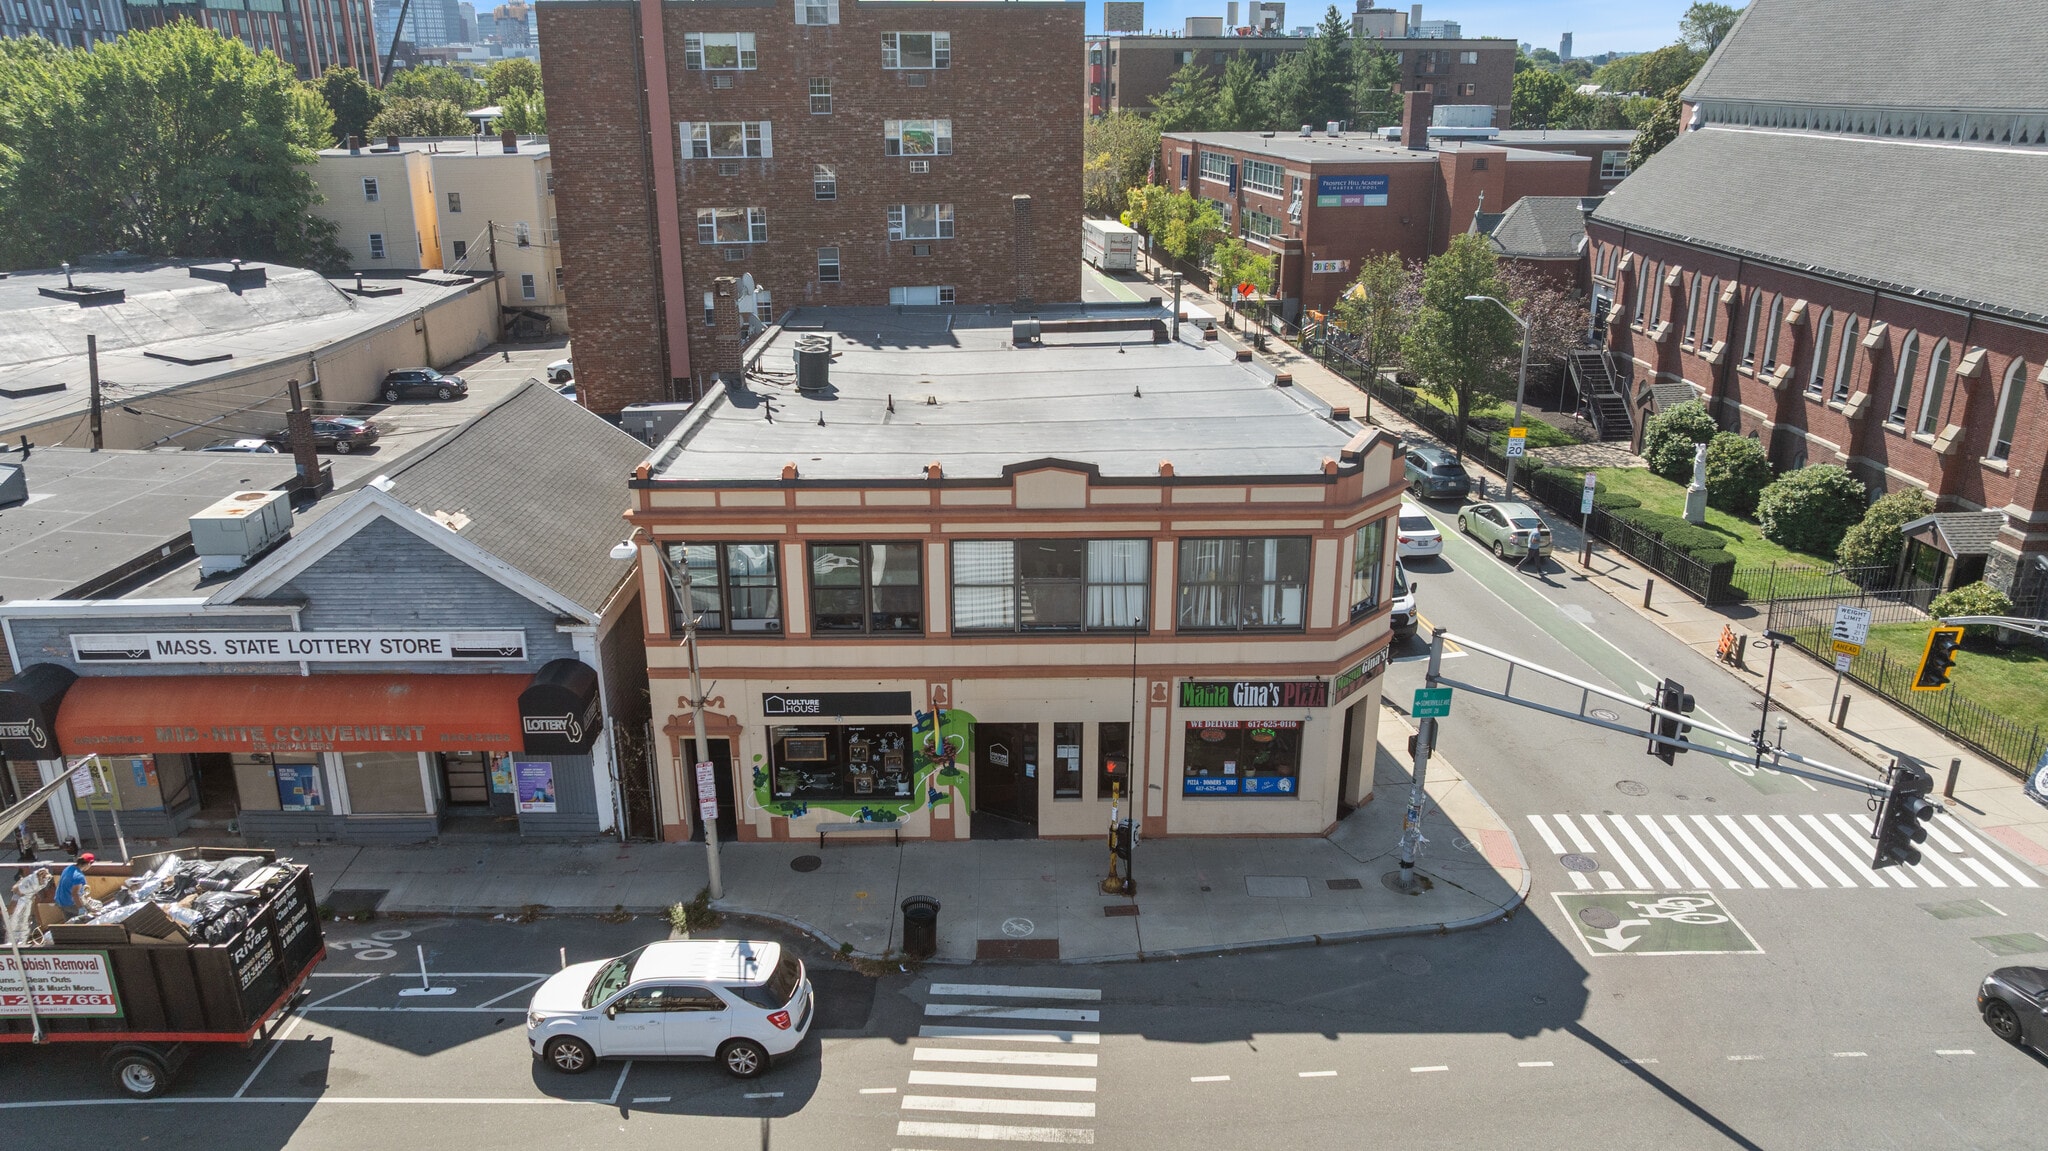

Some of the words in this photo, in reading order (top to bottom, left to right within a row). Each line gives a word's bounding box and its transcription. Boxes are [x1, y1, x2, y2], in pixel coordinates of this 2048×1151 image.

[1508, 446, 1522, 455] 20
[1841, 607, 1867, 617] WEIGHT
[1843, 614, 1862, 622] LIMIT
[156, 639, 217, 656] MASS.
[224, 639, 280, 655] STATE
[288, 638, 371, 655] LOTTERY
[380, 638, 442, 654] STORE
[1836, 643, 1857, 653] AHEAD
[1182, 682, 1229, 707] Mama
[1233, 682, 1280, 707] Gina's
[1283, 682, 1325, 707] PIZZA
[786, 705, 820, 713] HOUSE
[526, 719, 568, 731] LOTTERY
[1190, 720, 1203, 728] WE
[1205, 720, 1239, 728] DELIVER
[1247, 720, 1297, 728] 617-625-0116
[0, 725, 30, 736] TTERY
[272, 724, 426, 742] CONVENIENT
[1251, 728, 1276, 737] PIZZA
[253, 741, 334, 751] NEWSPAPERS
[234, 926, 269, 964] Rivas
[52, 957, 99, 971] Removal
